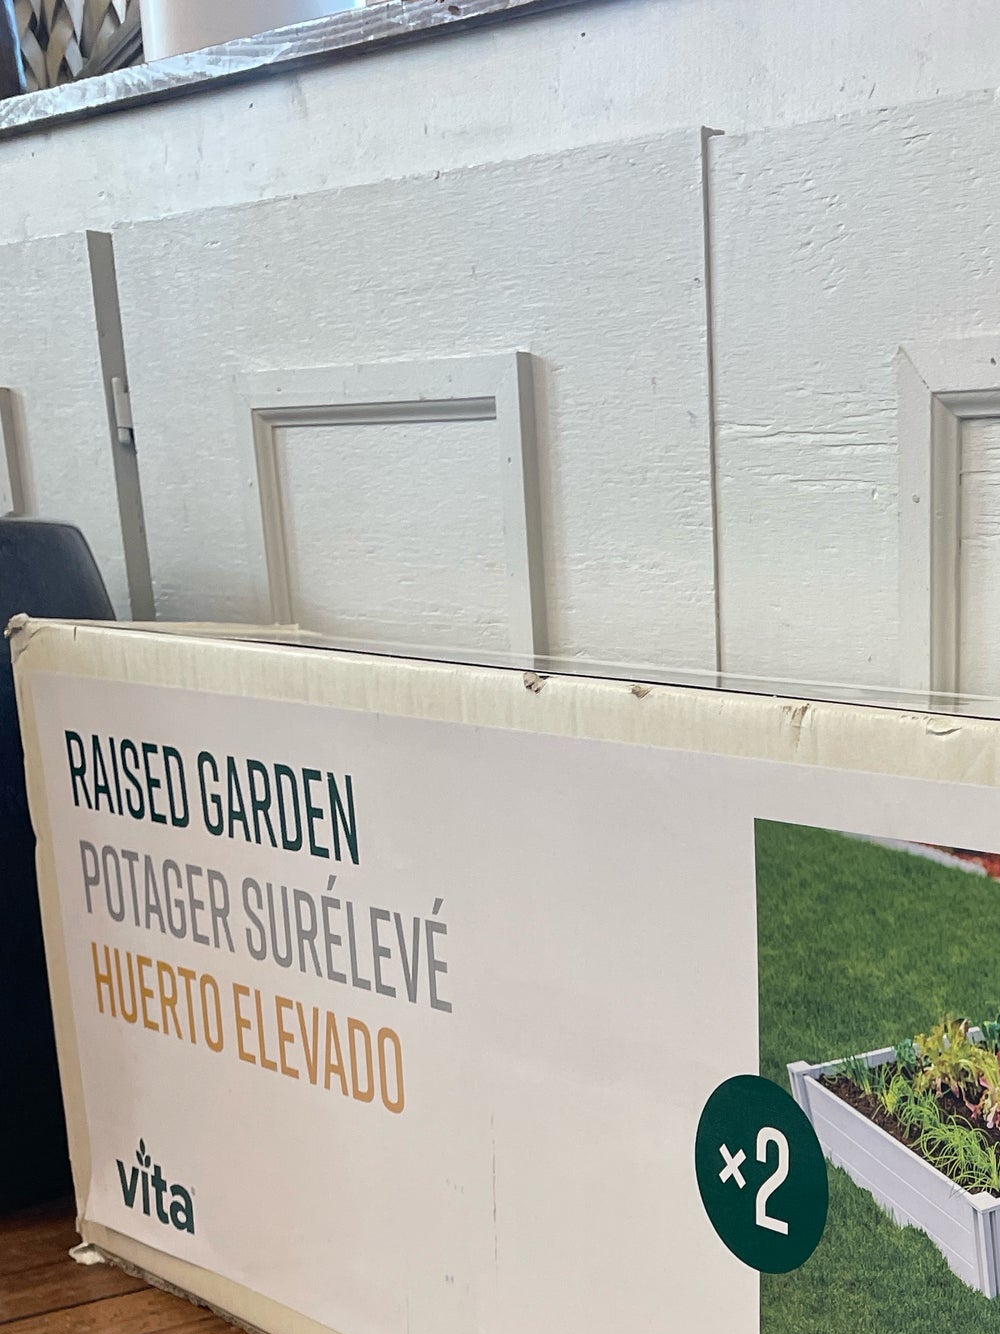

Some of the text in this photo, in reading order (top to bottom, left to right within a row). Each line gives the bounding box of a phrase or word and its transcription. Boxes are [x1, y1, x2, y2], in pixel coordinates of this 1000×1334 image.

[65, 729, 360, 865] RAISED GARDEN
[79, 839, 453, 1014] POTAGER SURÉLEVÉ
[91, 941, 406, 1114] HUERTO ELEVADO
